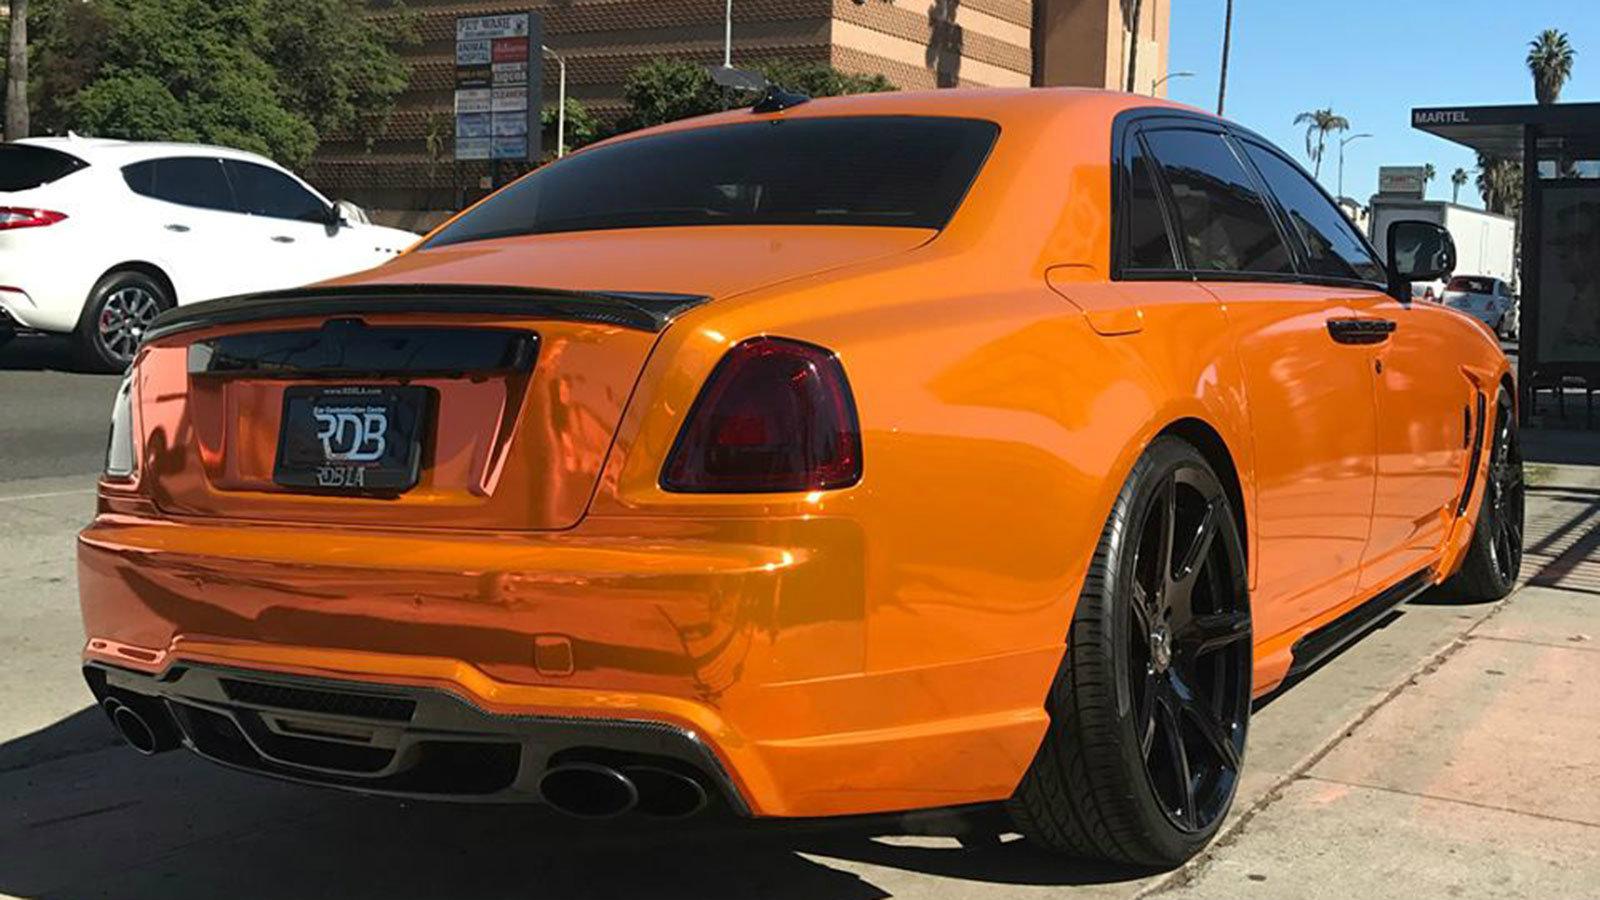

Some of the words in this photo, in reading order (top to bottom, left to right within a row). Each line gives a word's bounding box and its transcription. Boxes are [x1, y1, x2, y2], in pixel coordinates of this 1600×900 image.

[482, 17, 511, 29] WASH
[458, 42, 489, 52] ANIMAL
[1415, 111, 1469, 123] MARTEL
[314, 412, 388, 461] RDB
